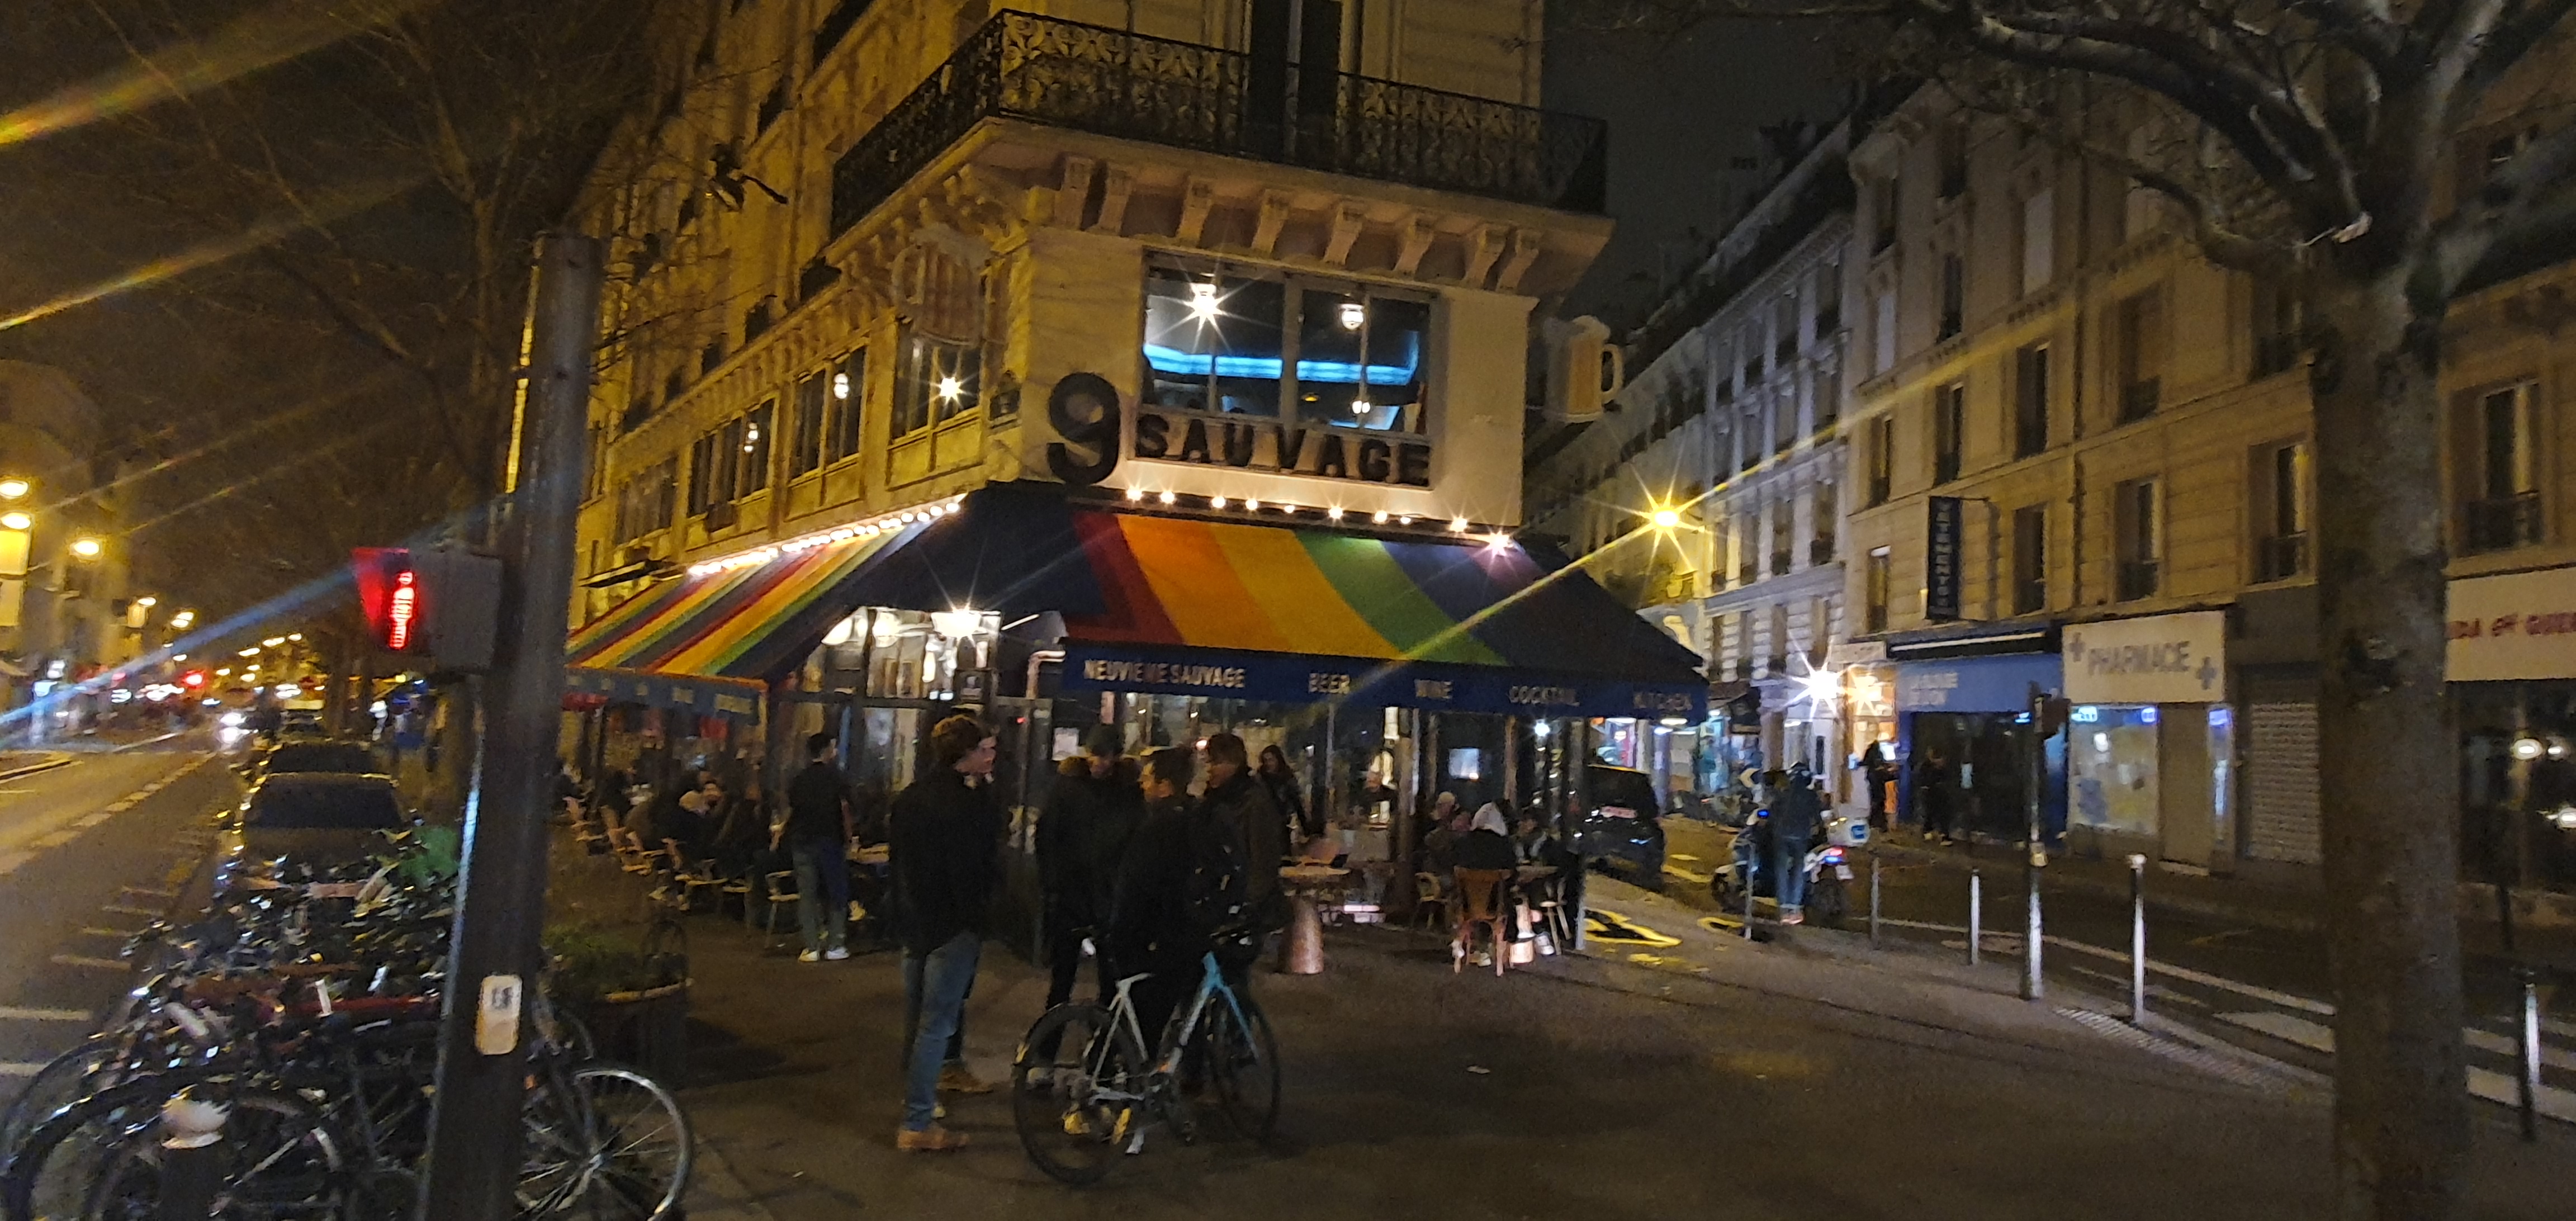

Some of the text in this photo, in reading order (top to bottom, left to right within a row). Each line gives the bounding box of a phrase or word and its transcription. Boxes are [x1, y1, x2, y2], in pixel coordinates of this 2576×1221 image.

[1046, 372, 1431, 488] 9 SAUVAGE
[1170, 663, 1246, 688] SAUVAGE
[1308, 673, 1350, 694] BEER
[1414, 679, 1453, 699] WINE
[1508, 685, 1580, 707] COCKTAIL
[1633, 692, 1694, 711] KITCHEN
